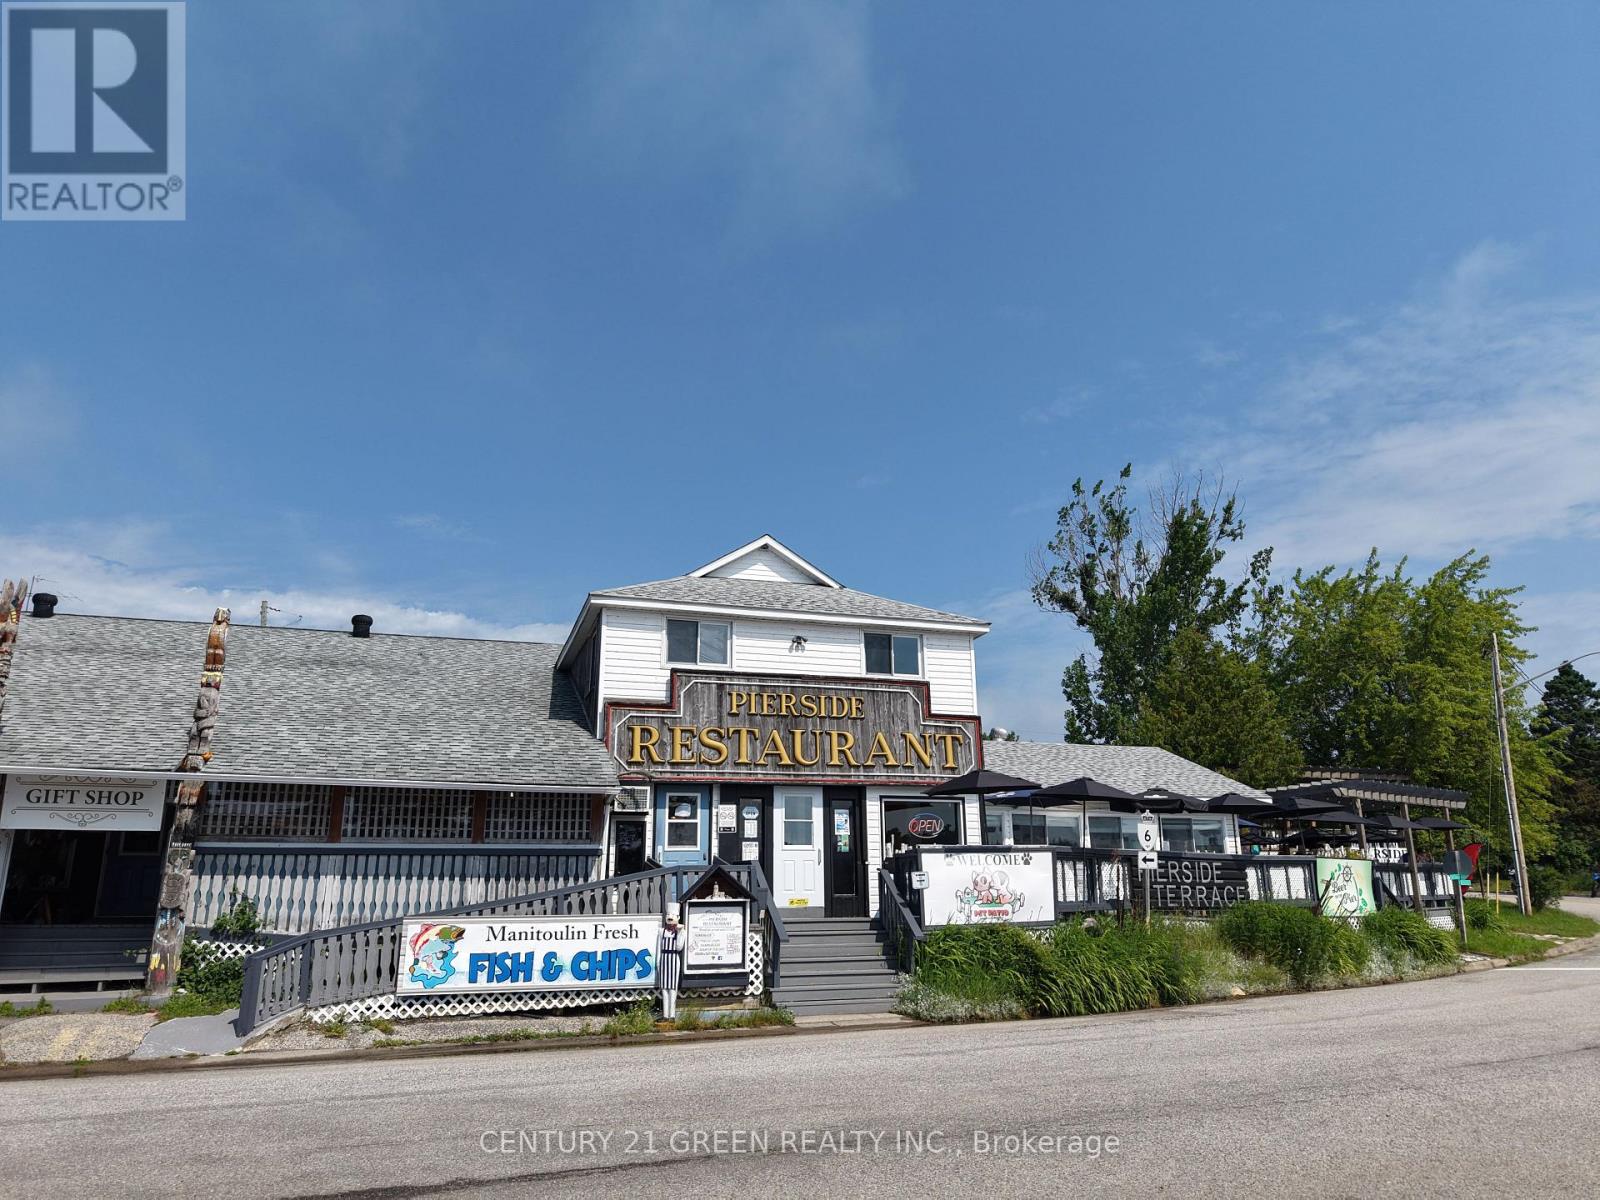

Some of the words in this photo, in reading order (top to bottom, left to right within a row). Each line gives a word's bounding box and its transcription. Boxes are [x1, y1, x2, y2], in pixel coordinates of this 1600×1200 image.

[728, 691, 865, 719] PIERSIDE
[627, 724, 963, 768] RESTAURANT
[26, 788, 80, 804] GIFT
[84, 790, 144, 806] SHOP
[909, 819, 941, 833] OPEN
[1144, 830, 1152, 842] 6
[957, 854, 1020, 866] WELCOME
[1153, 885, 1245, 907] TERRACE
[486, 925, 590, 942] Manitoulin
[592, 923, 639, 940] Fresh
[468, 951, 535, 983] FISH
[541, 951, 563, 982] &
[570, 948, 652, 981] CHIPS
